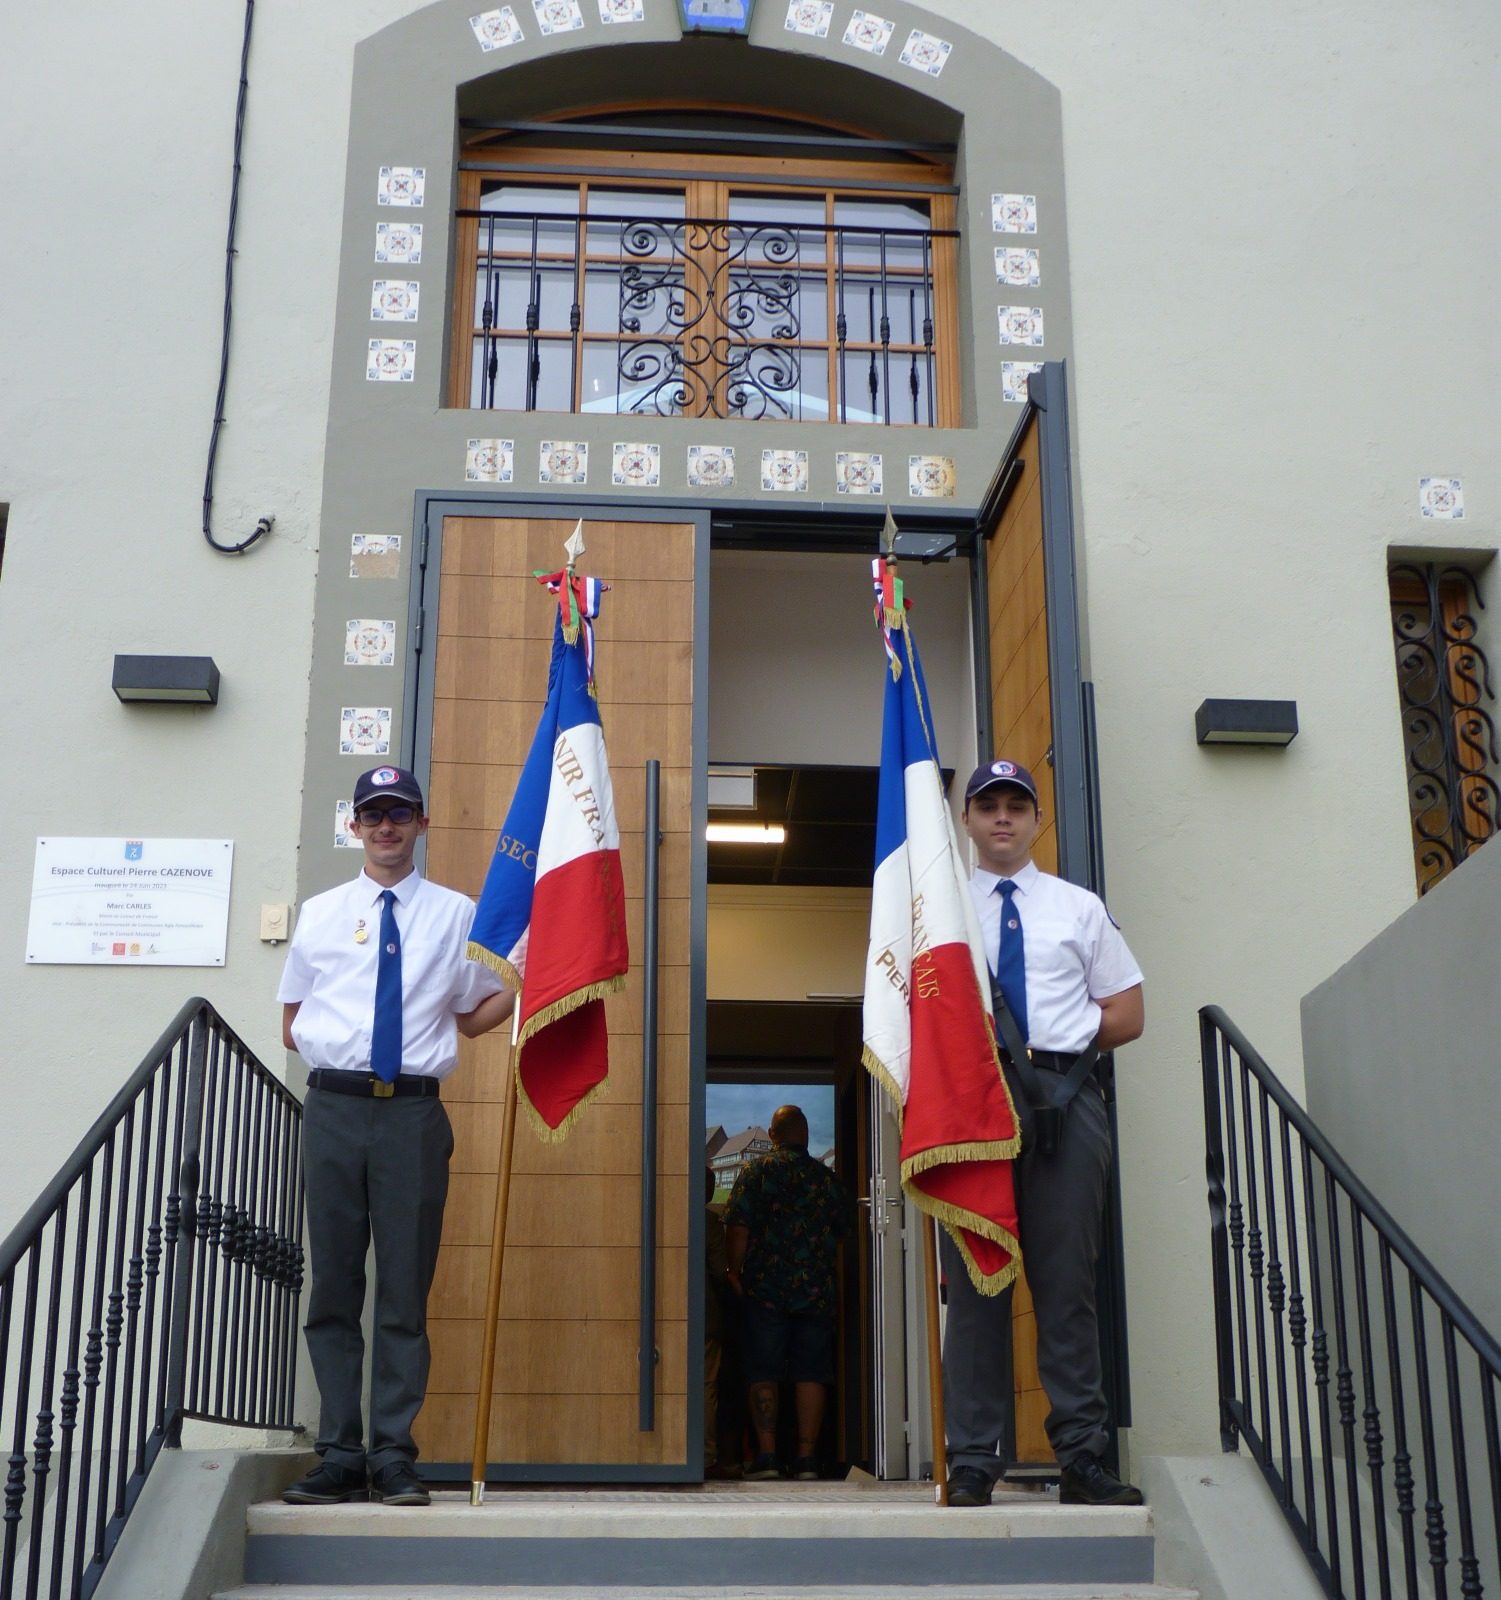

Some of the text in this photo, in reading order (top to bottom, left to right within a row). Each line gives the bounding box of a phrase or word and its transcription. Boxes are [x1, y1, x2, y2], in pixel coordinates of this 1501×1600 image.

[51, 866, 214, 878] Espace Culturel Pierre CAZENOVE
[106, 902, 125, 910] Marc
[875, 948, 912, 1007] PIER
